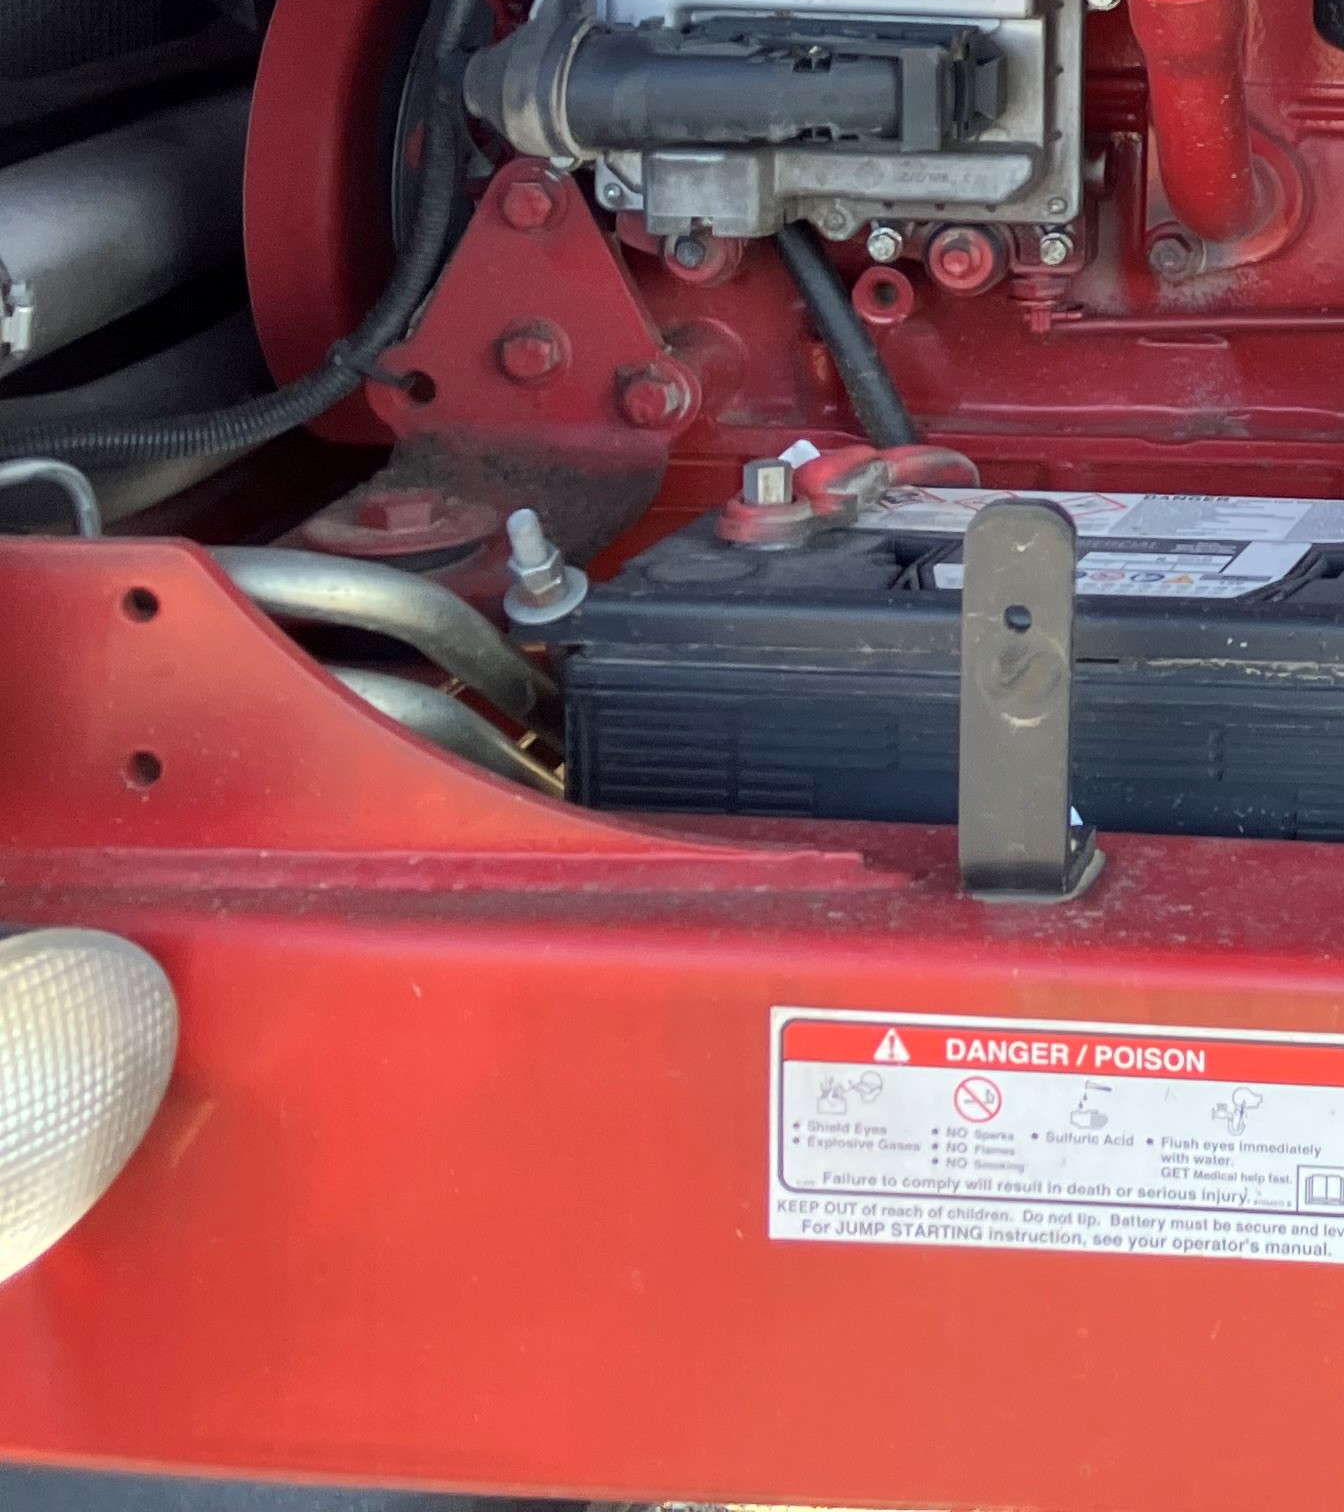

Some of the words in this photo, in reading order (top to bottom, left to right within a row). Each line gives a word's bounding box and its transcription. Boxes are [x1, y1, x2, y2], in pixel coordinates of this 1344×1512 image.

[946, 1037, 1069, 1067] DANGER
[1094, 1043, 1206, 1074] POISON
[807, 1120, 850, 1135] Shield
[854, 1123, 887, 1138] Eyes
[946, 1127, 968, 1140] NO
[807, 1136, 874, 1152] Explosive
[878, 1139, 921, 1152] Gases
[1045, 1130, 1100, 1145] Sulfuric
[1103, 1133, 1134, 1147] Acid
[1161, 1136, 1199, 1151] Flush
[1203, 1141, 1236, 1154] eyes
[1239, 1140, 1322, 1159] immediately
[946, 1142, 968, 1154] NO
[946, 1157, 968, 1169] NO
[1161, 1152, 1189, 1165] with
[1193, 1154, 1235, 1168] water.
[1161, 1167, 1188, 1180] GET
[1193, 1169, 1237, 1182] Medical
[1240, 1172, 1266, 1186] help
[1268, 1172, 1294, 1186] fast.
[822, 1171, 877, 1188] Failure
[881, 1174, 897, 1189] to
[902, 1176, 961, 1194] comply
[965, 1176, 993, 1192] will
[997, 1178, 1044, 1195] result
[1047, 1180, 1062, 1195] in
[1066, 1181, 1111, 1198] death
[1116, 1186, 1133, 1199] or
[1137, 1186, 1197, 1202] serious
[1201, 1188, 1251, 1208] injury.
[777, 1199, 820, 1214] KEEP
[824, 1201, 857, 1216] OUT
[861, 1202, 877, 1217] of
[881, 1204, 923, 1219] reach
[927, 1205, 943, 1219] of
[947, 1206, 1013, 1223] children.
[1022, 1209, 1044, 1224] Do
[1048, 1211, 1072, 1226] not
[1077, 1213, 1101, 1228] tip.
[1110, 1213, 1166, 1232] Battery
[1170, 1217, 1208, 1232] must
[1213, 1218, 1231, 1233] be
[1236, 1222, 1287, 1235] secure
[1291, 1221, 1319, 1237] and
[802, 1219, 830, 1235] For
[835, 1220, 885, 1237] JUMP
[891, 1223, 983, 1241] STARTING
[989, 1226, 1087, 1248] instruction,
[1093, 1234, 1122, 1248] see
[1128, 1235, 1167, 1251] your
[1173, 1236, 1260, 1254] operator's
[1265, 1241, 1333, 1257] manual.
